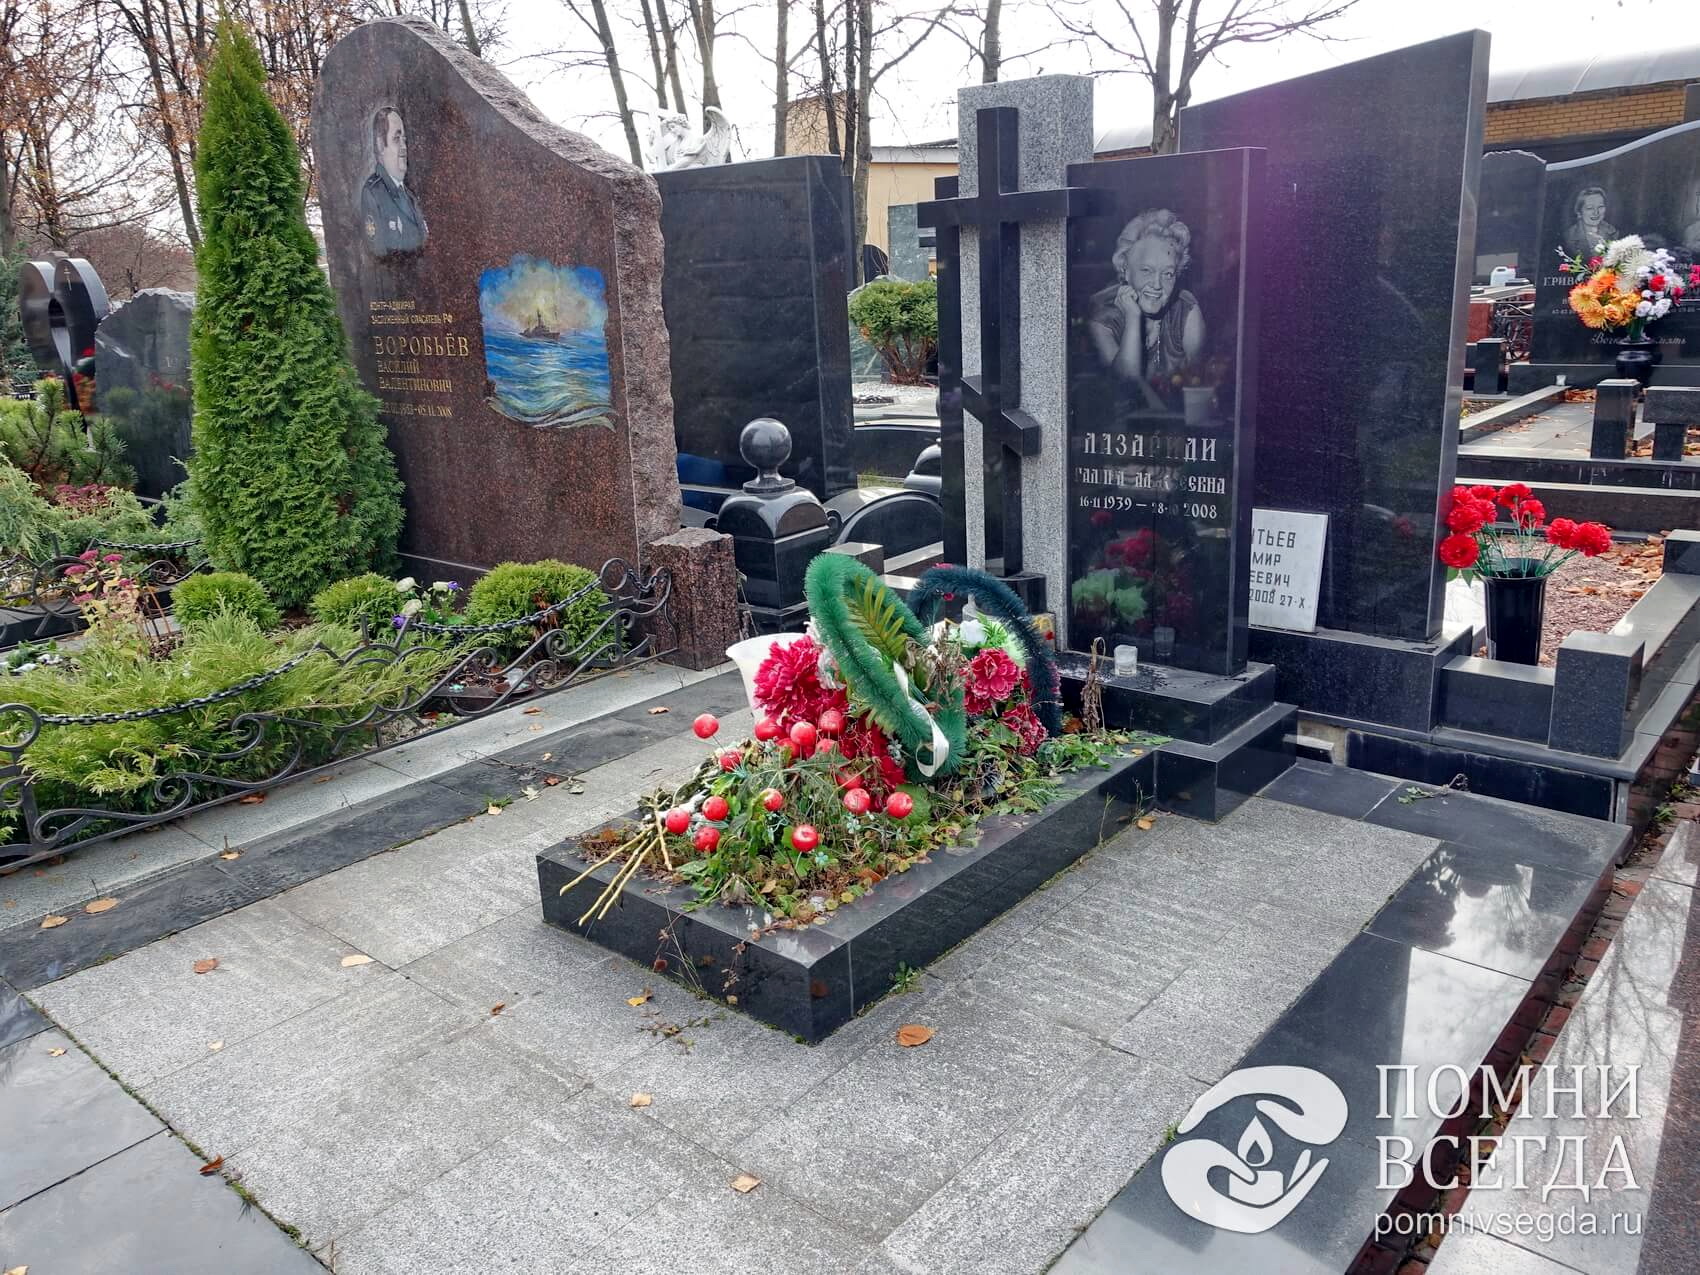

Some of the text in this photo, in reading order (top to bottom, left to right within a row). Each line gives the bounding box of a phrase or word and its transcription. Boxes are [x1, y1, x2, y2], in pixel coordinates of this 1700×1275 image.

[373, 333, 470, 357] ВОРОБЬЁВ
[1103, 495, 1133, 511] 1939
[1183, 502, 1218, 519] 2008
[1252, 528, 1297, 548] ТЬЕВ
